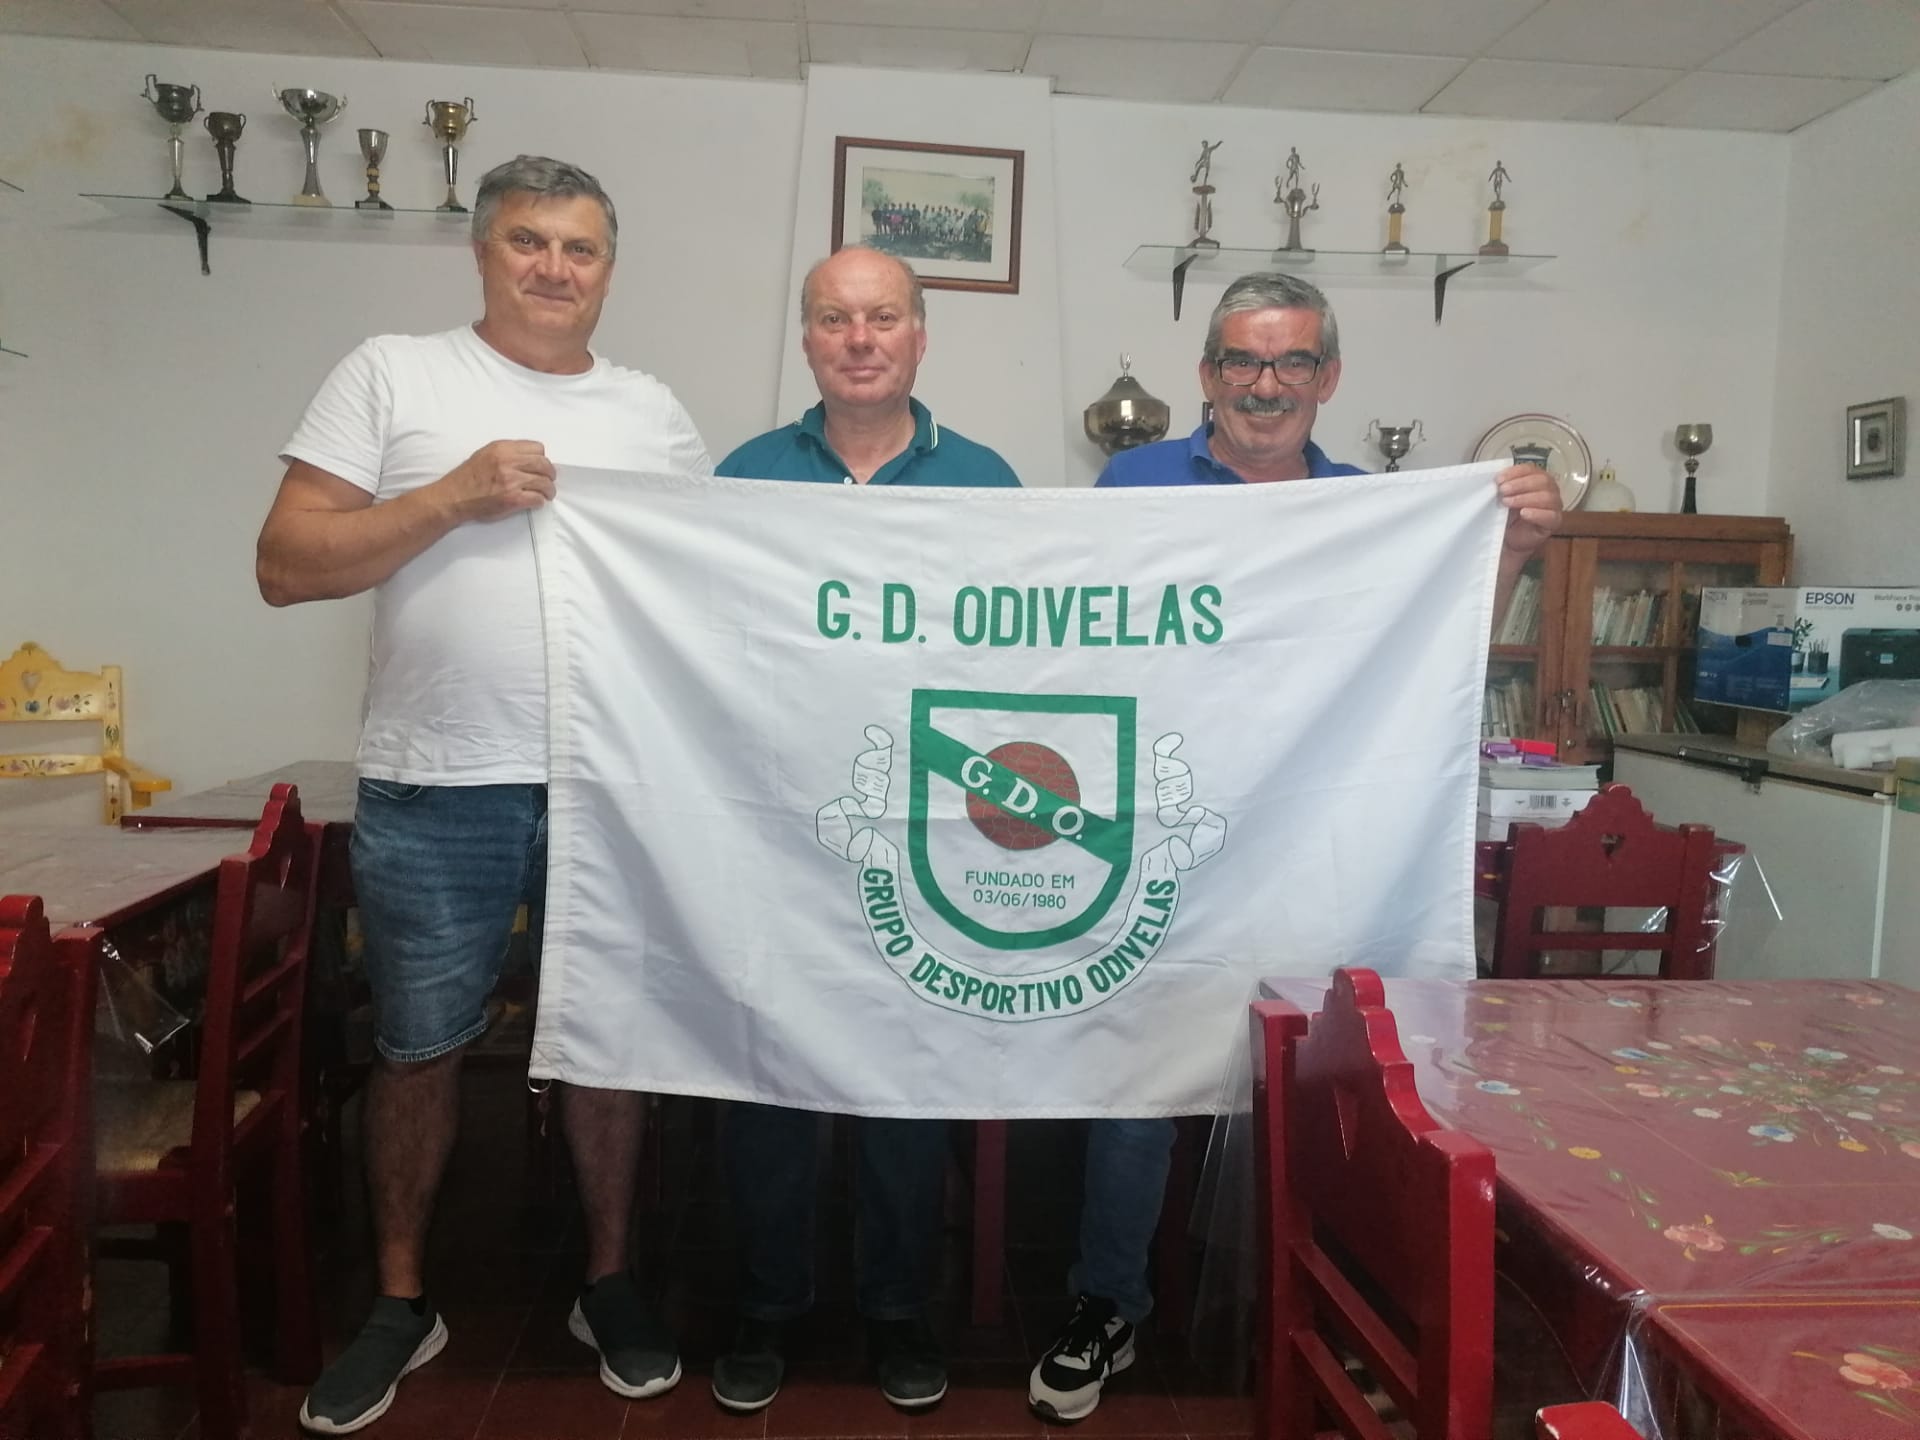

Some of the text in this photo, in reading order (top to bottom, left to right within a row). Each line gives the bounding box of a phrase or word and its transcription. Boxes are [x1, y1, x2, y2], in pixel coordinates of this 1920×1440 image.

[816, 579, 1225, 648] G. D. ODIVELAS
[1805, 592, 1855, 605] EPSON
[961, 755, 993, 796] G.
[1001, 777, 1038, 819] D.
[965, 871, 1075, 890] FUNDADO EM
[973, 889, 1066, 910] 03/06/1980
[863, 867, 1177, 1014] GRUPO DESPORTIVO ODIVELAS
